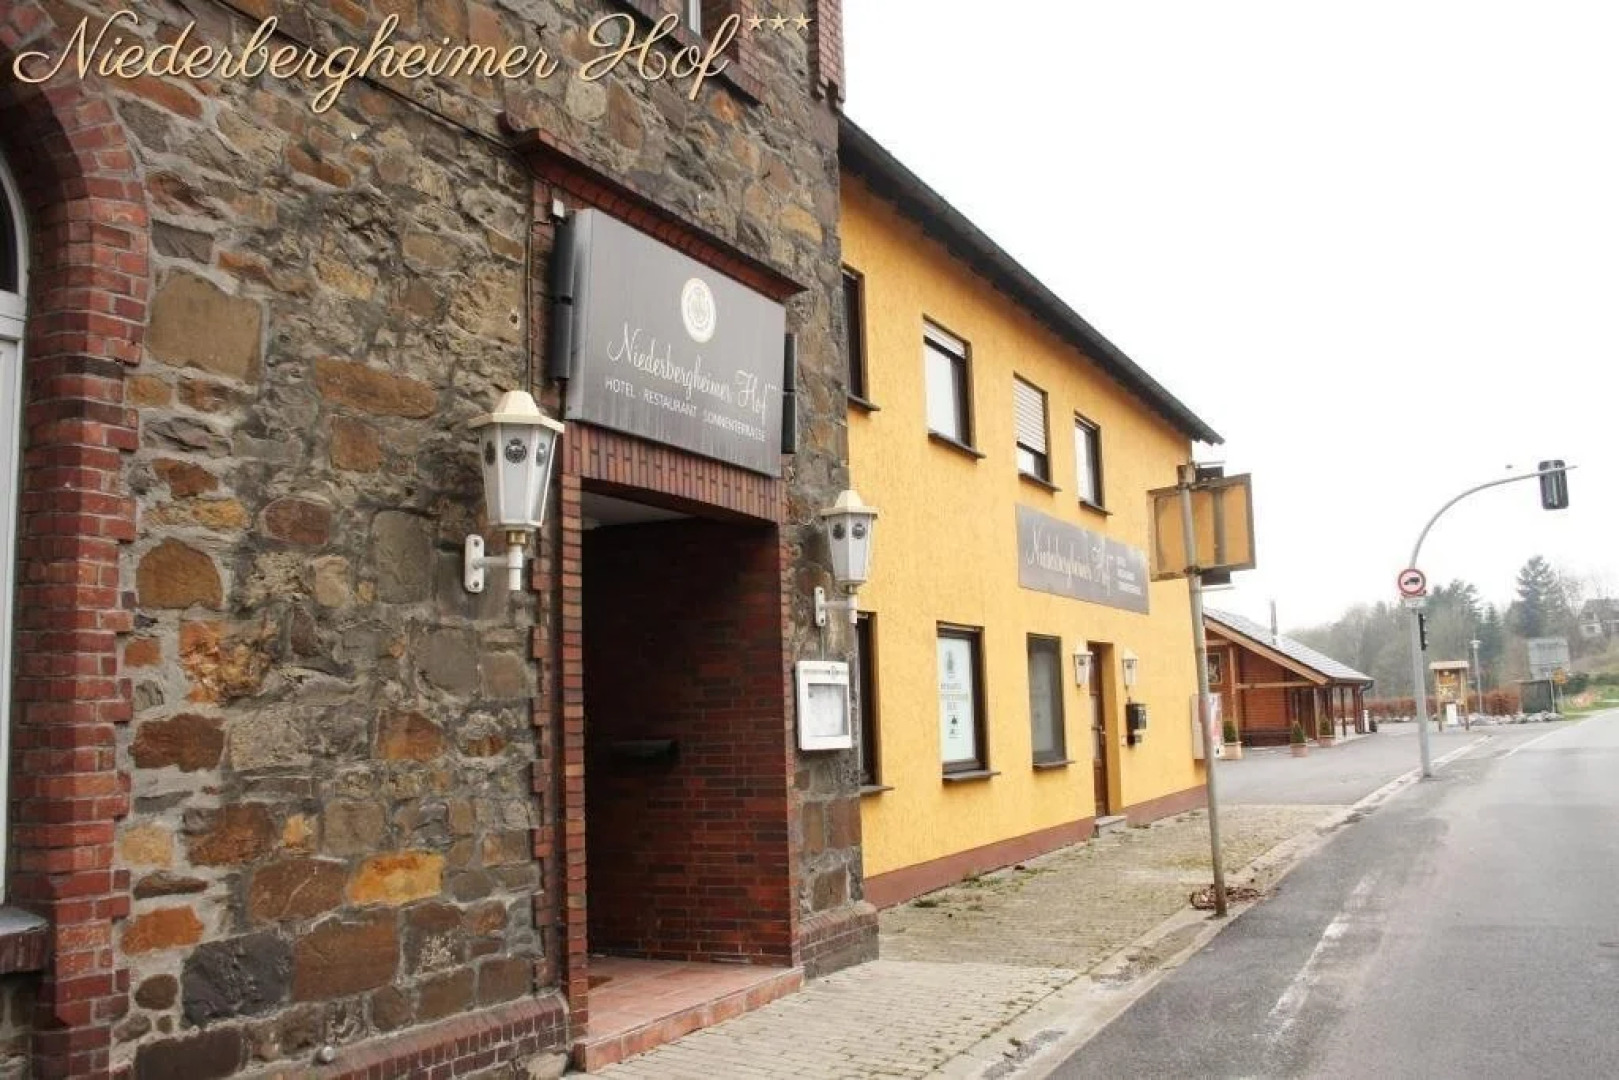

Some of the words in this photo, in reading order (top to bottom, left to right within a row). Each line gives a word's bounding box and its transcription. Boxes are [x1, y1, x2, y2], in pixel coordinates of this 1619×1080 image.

[605, 378, 636, 399] HOTEL
[643, 389, 697, 418] RESTAURANT
[606, 321, 733, 403] Niederbergheimer
[734, 369, 769, 426] Hof
